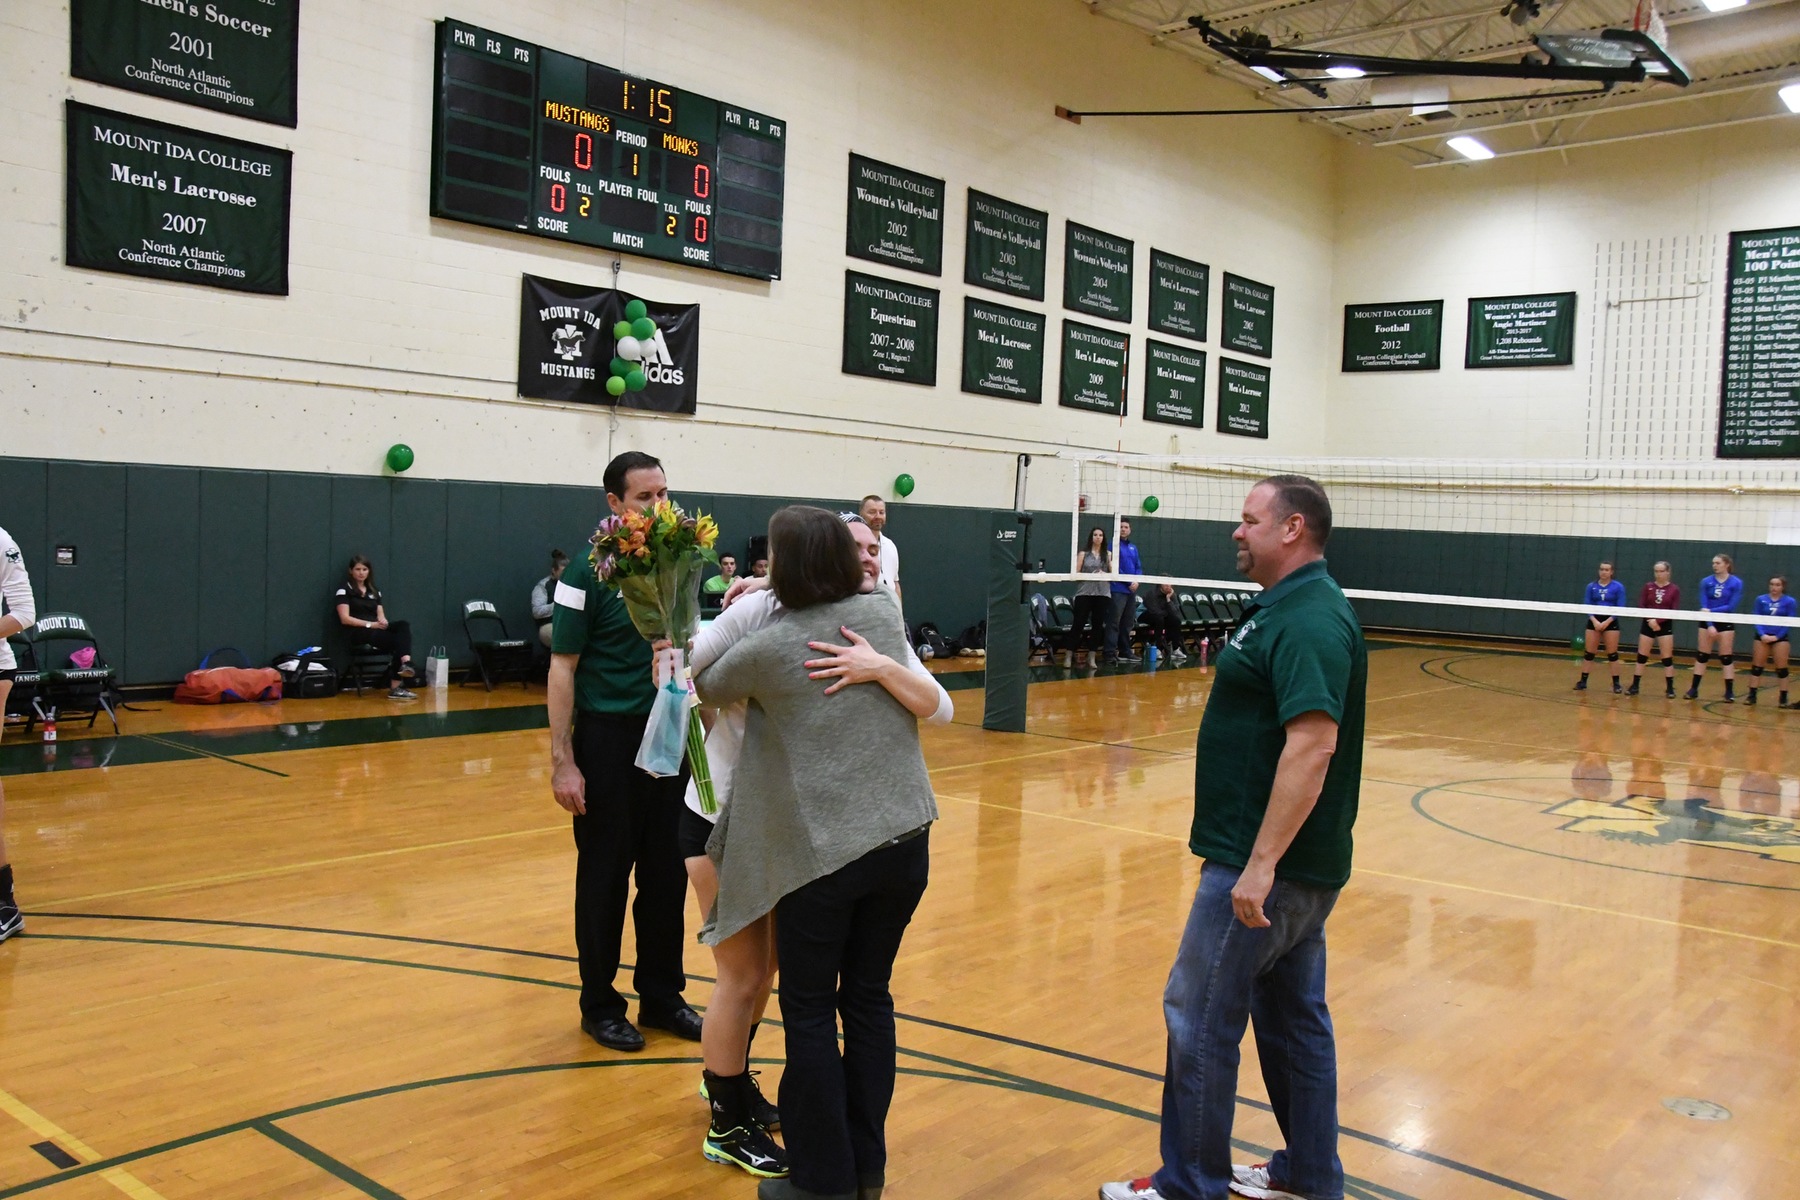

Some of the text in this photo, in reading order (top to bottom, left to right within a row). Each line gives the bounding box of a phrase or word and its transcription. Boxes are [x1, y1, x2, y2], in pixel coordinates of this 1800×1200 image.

[205, 4, 272, 38] Soccer
[170, 32, 214, 60] 2001
[455, 30, 529, 63] PLYR FLS PTS
[151, 58, 231, 88] North Atlantic
[125, 65, 254, 106] Conference Champions
[546, 101, 610, 133] MUSTANGS
[726, 111, 781, 140] PLYR FLS PTS
[616, 130, 647, 149] PERIOD
[664, 133, 698, 157] MONKS
[94, 126, 272, 177] MOUNT IDA COLLEGE
[575, 133, 592, 169] 0
[540, 166, 571, 183] FOULS
[633, 153, 638, 176] 1
[111, 163, 256, 207] Men's Lacrosse
[694, 164, 709, 198] 0
[861, 167, 935, 198] MOUNT IDA COLLEGE
[551, 184, 565, 212] 0
[599, 180, 659, 204] PLAYER FOUL
[579, 197, 590, 216] 2
[686, 200, 711, 216] FOULS
[856, 187, 939, 221] Women's Volleyball
[163, 213, 206, 235] 2007
[538, 217, 569, 233] SCORE
[666, 216, 677, 236] 2
[976, 202, 1000, 217] MOUNT
[1013, 214, 1040, 230] COLLEGE
[694, 216, 707, 242] 0
[887, 221, 908, 237] 2002
[974, 220, 1041, 250] Women's Volleyball
[142, 239, 225, 262] North Atlantic
[613, 232, 643, 249] MATCH
[1741, 236, 1800, 248] MOUNT IDA
[118, 249, 245, 278] Conference Champions
[684, 247, 709, 262] SCORE
[1000, 252, 1016, 266] 2003
[1744, 248, 1779, 260] Men's
[1744, 261, 1769, 272] 100
[855, 283, 932, 308] MOUNT IDA COLLEGE
[1484, 303, 1511, 311] MOUNT
[1524, 300, 1557, 309] COLLEGE
[539, 306, 601, 330] MOUNT IDA
[870, 307, 916, 328] Equestrian
[973, 309, 1037, 332] MOUNT IDA COLLEGE
[1354, 311, 1382, 319] MOUNT
[1397, 308, 1433, 317] COLLEGE
[1484, 309, 1557, 320] Women's Basketball
[1375, 323, 1410, 333] Football
[1492, 319, 1547, 329] Angie Martinez
[870, 333, 915, 351] 2007 2008
[978, 329, 1031, 350] Men's Lacrosse
[1070, 330, 1125, 350] MOUNT COLLEGE
[1381, 340, 1401, 350] 2012
[1513, 336, 1542, 344] Rebounds
[996, 357, 1014, 370] 2008
[1075, 349, 1119, 368] Men's Lacrosse
[1376, 353, 1403, 361] Collegiate
[1404, 352, 1426, 360] Football
[541, 362, 595, 380] MUSTANGS
[641, 361, 685, 384] idas
[1089, 373, 1104, 385] 2009
[1600, 593, 1606, 601] 1
[1655, 594, 1664, 604] 3
[1714, 589, 1722, 598] 5
[36, 617, 86, 633] MOUNT IDA
[66, 671, 108, 679] MUSTANGS
